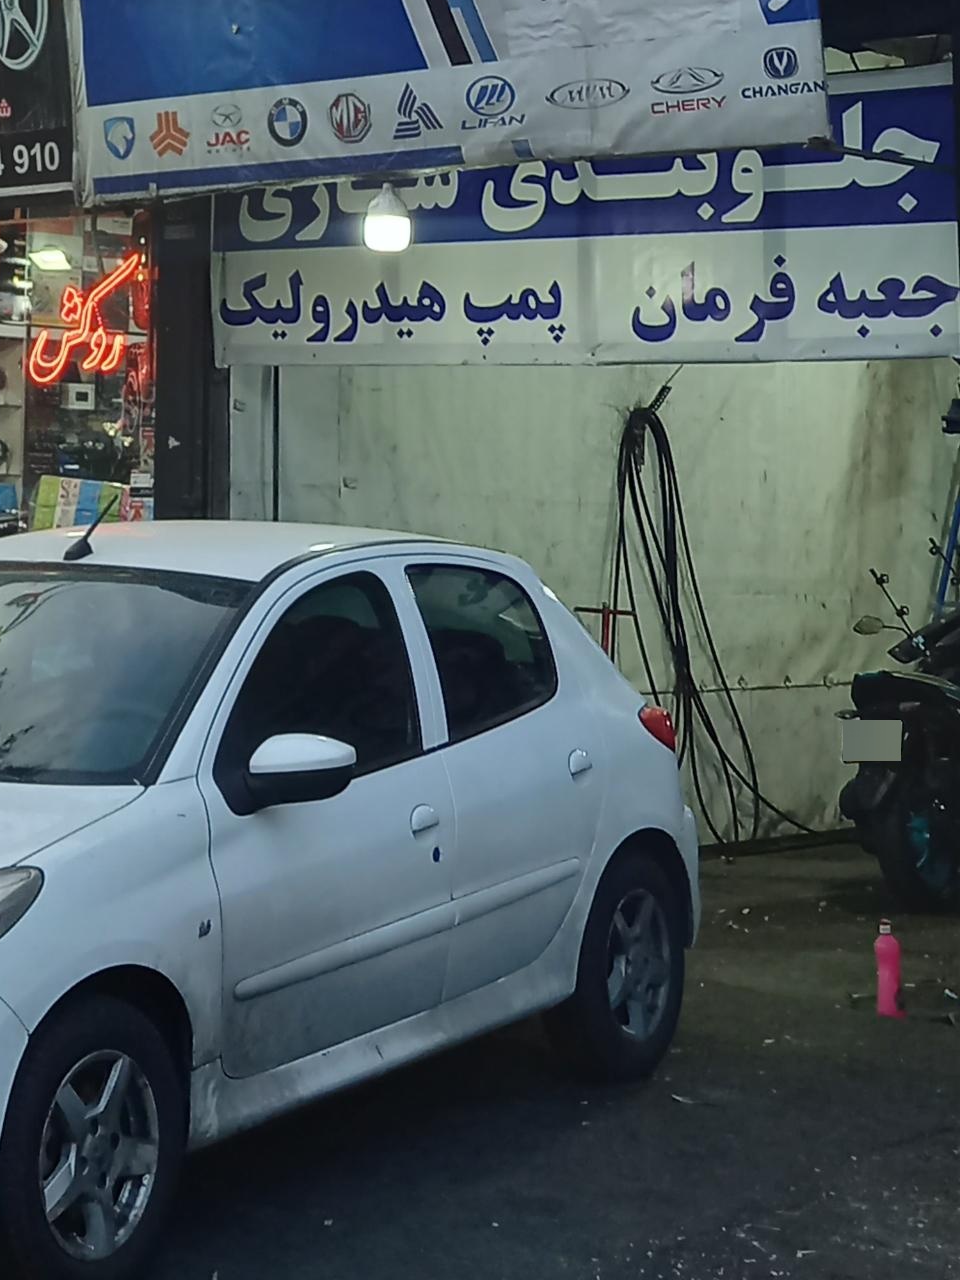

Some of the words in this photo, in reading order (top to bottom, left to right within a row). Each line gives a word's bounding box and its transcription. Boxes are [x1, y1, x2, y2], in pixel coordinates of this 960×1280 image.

[651, 96, 727, 115] CHERY
[741, 80, 828, 99] CHANGAN
[207, 129, 251, 148] JAC
[461, 113, 526, 131] LIFAN
[12, 140, 60, 175] 910
[29, 252, 139, 383] روکش
[219, 270, 447, 342] هیدرولیک
[462, 280, 566, 347] پمپ
[631, 255, 796, 344] فرمان
[817, 271, 960, 338] جعبه
